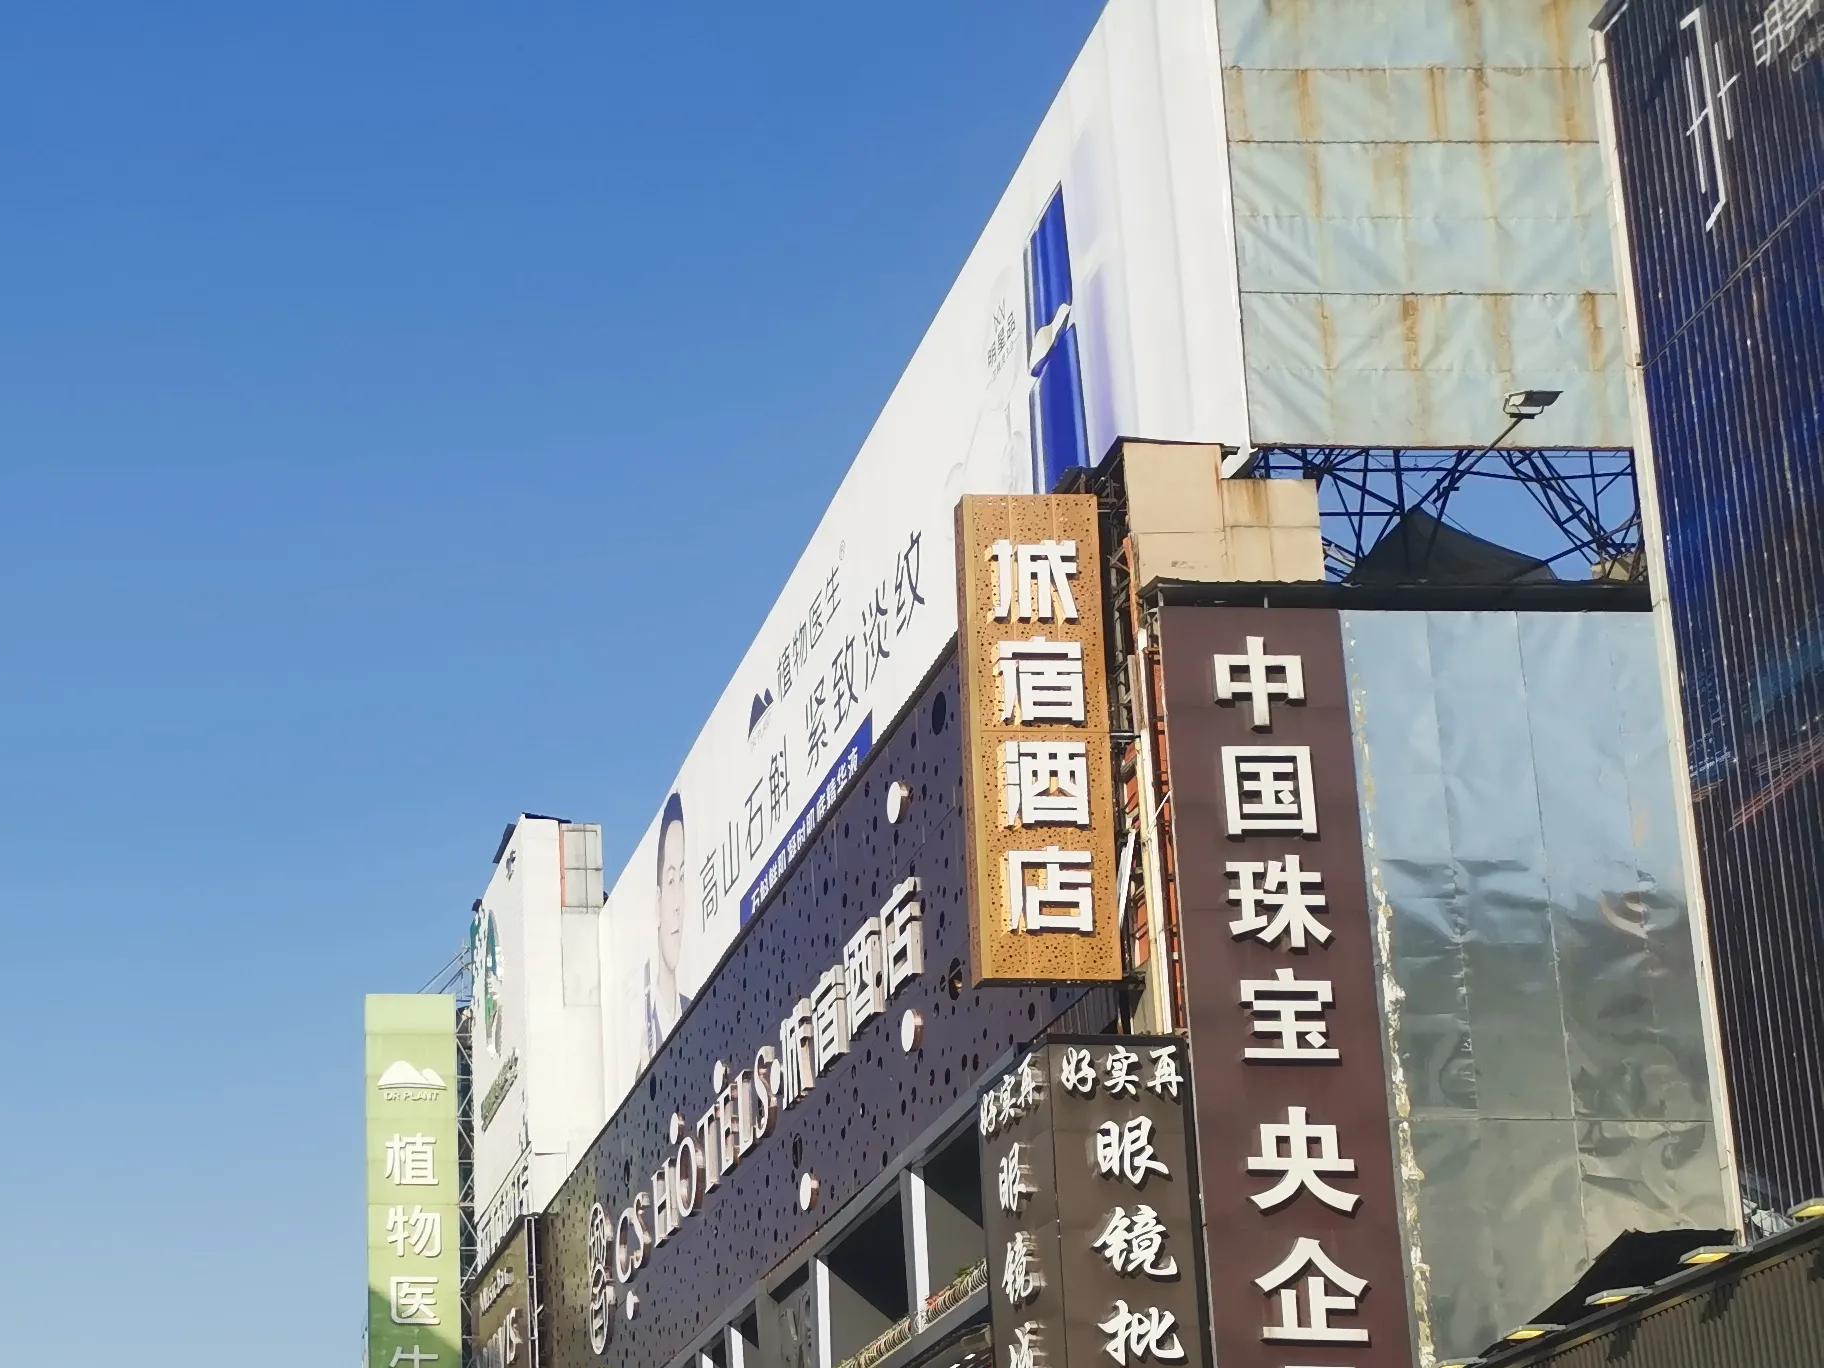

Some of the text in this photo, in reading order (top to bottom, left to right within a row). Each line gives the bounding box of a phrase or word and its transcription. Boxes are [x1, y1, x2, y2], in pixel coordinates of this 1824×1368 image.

[700, 529, 926, 934] 高山石斛 紧致淡纹
[777, 566, 841, 702] 植物医生
[985, 539, 1094, 933] 城宿酒店
[1213, 636, 1340, 1060] 中国珠宝
[652, 1045, 777, 1247] HOTELS
[781, 877, 924, 1109] 城宿酒店
[980, 1053, 1039, 1136] 好实再
[1062, 1045, 1184, 1096] 好实再
